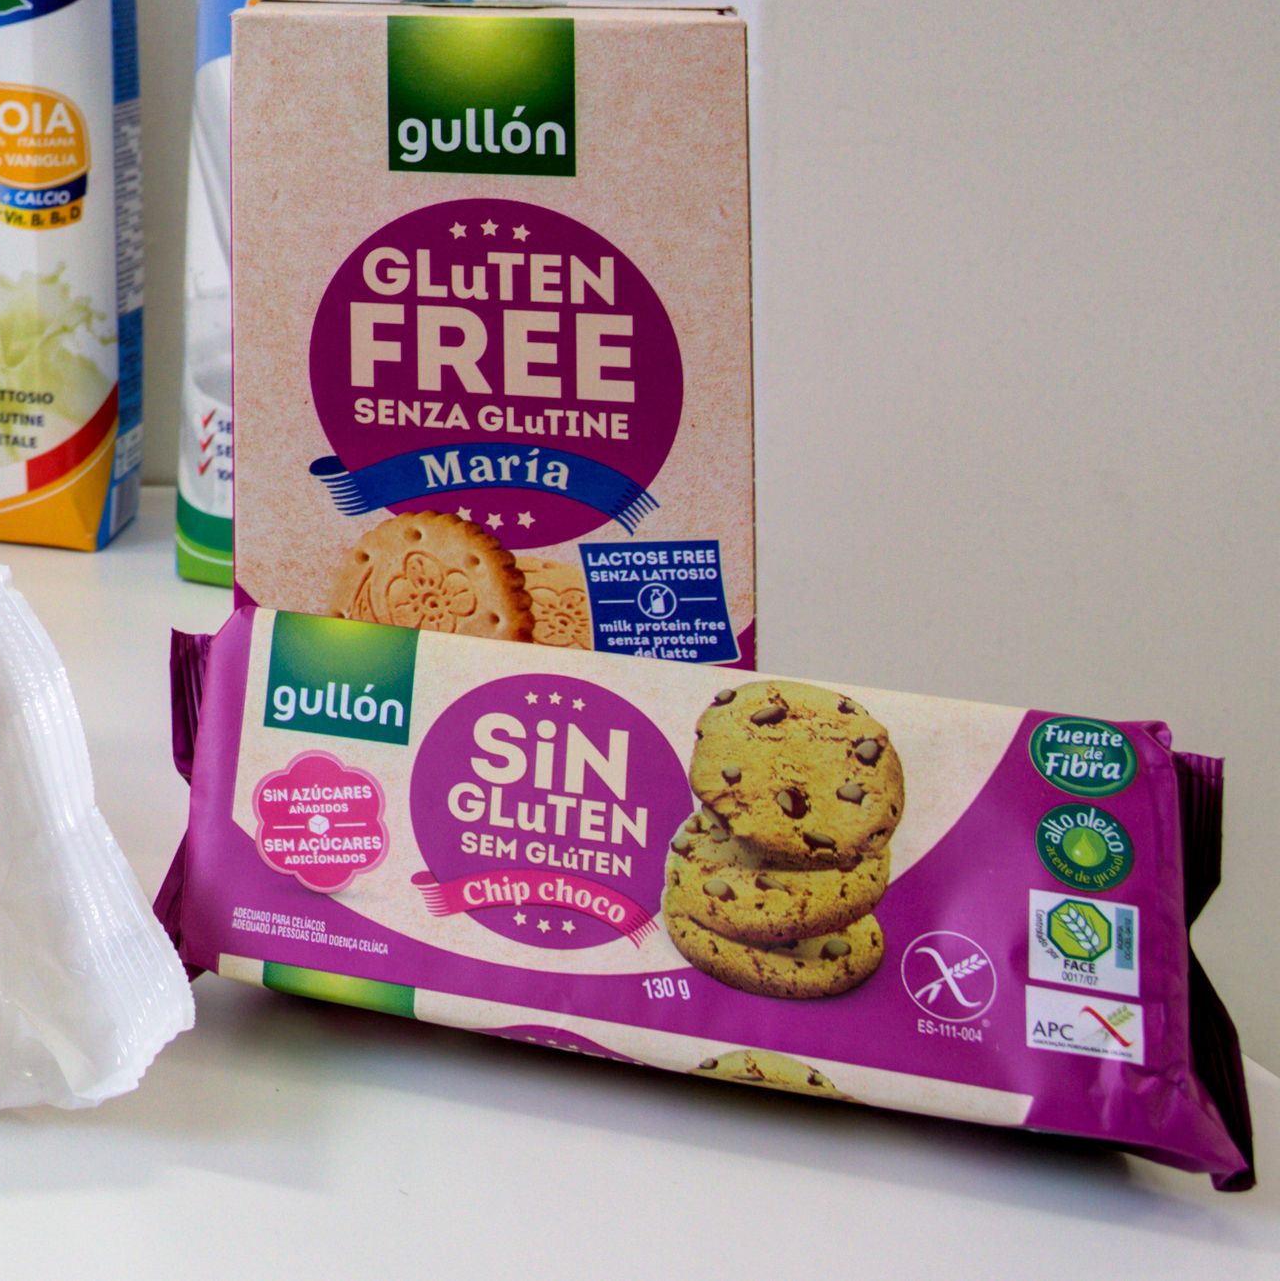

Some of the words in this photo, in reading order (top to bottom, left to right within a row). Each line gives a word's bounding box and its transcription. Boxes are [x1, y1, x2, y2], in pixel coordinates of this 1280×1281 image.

[397, 105, 567, 163] gullón
[4, 153, 78, 168] VANIGLIA
[15, 190, 71, 206] CALCIO
[349, 301, 636, 404] FREE
[353, 397, 471, 431] SENZA
[419, 447, 571, 490] María
[587, 550, 669, 567] LACTOSE
[673, 549, 717, 565] FREE
[591, 570, 640, 583] SENZA
[642, 568, 718, 582] LATTOSIO
[599, 620, 633, 633] milk
[636, 619, 691, 636] protein
[694, 618, 727, 631] free
[607, 635, 650, 647] senza
[654, 633, 718, 649] proteine
[660, 647, 699, 660] latte
[272, 681, 404, 728] gullón
[1044, 723, 1124, 748] Fuente
[1044, 751, 1122, 781] Fibra
[1082, 747, 1104, 761] de
[291, 783, 373, 802] AZÚCARES
[288, 802, 350, 815] AÑADIDOS
[1042, 813, 1074, 845] alto
[1076, 807, 1125, 854] oleico
[264, 837, 296, 853] SEM
[298, 833, 383, 855] AÇÚCARES
[460, 831, 518, 861] SEM
[284, 852, 368, 866] ADICIONADOS
[1045, 844, 1074, 877] aceite
[1074, 869, 1091, 884] de
[463, 875, 531, 907] Chip
[538, 878, 627, 924] choco
[232, 906, 271, 924] ADECUADO
[271, 912, 291, 928] PARA
[292, 914, 327, 933] CELÍACOS
[231, 918, 270, 936] ADEQUADO
[270, 923, 278, 937] A
[277, 924, 310, 943] PESSOAS
[310, 928, 329, 945] COM
[328, 933, 359, 952] DOENÇA
[358, 937, 390, 956] CELÍACA
[1062, 958, 1097, 974] FACE
[641, 977, 675, 1000] 130
[678, 977, 692, 1001] g
[916, 1017, 983, 1043] ES-111-004
[1032, 1020, 1075, 1042] APC
